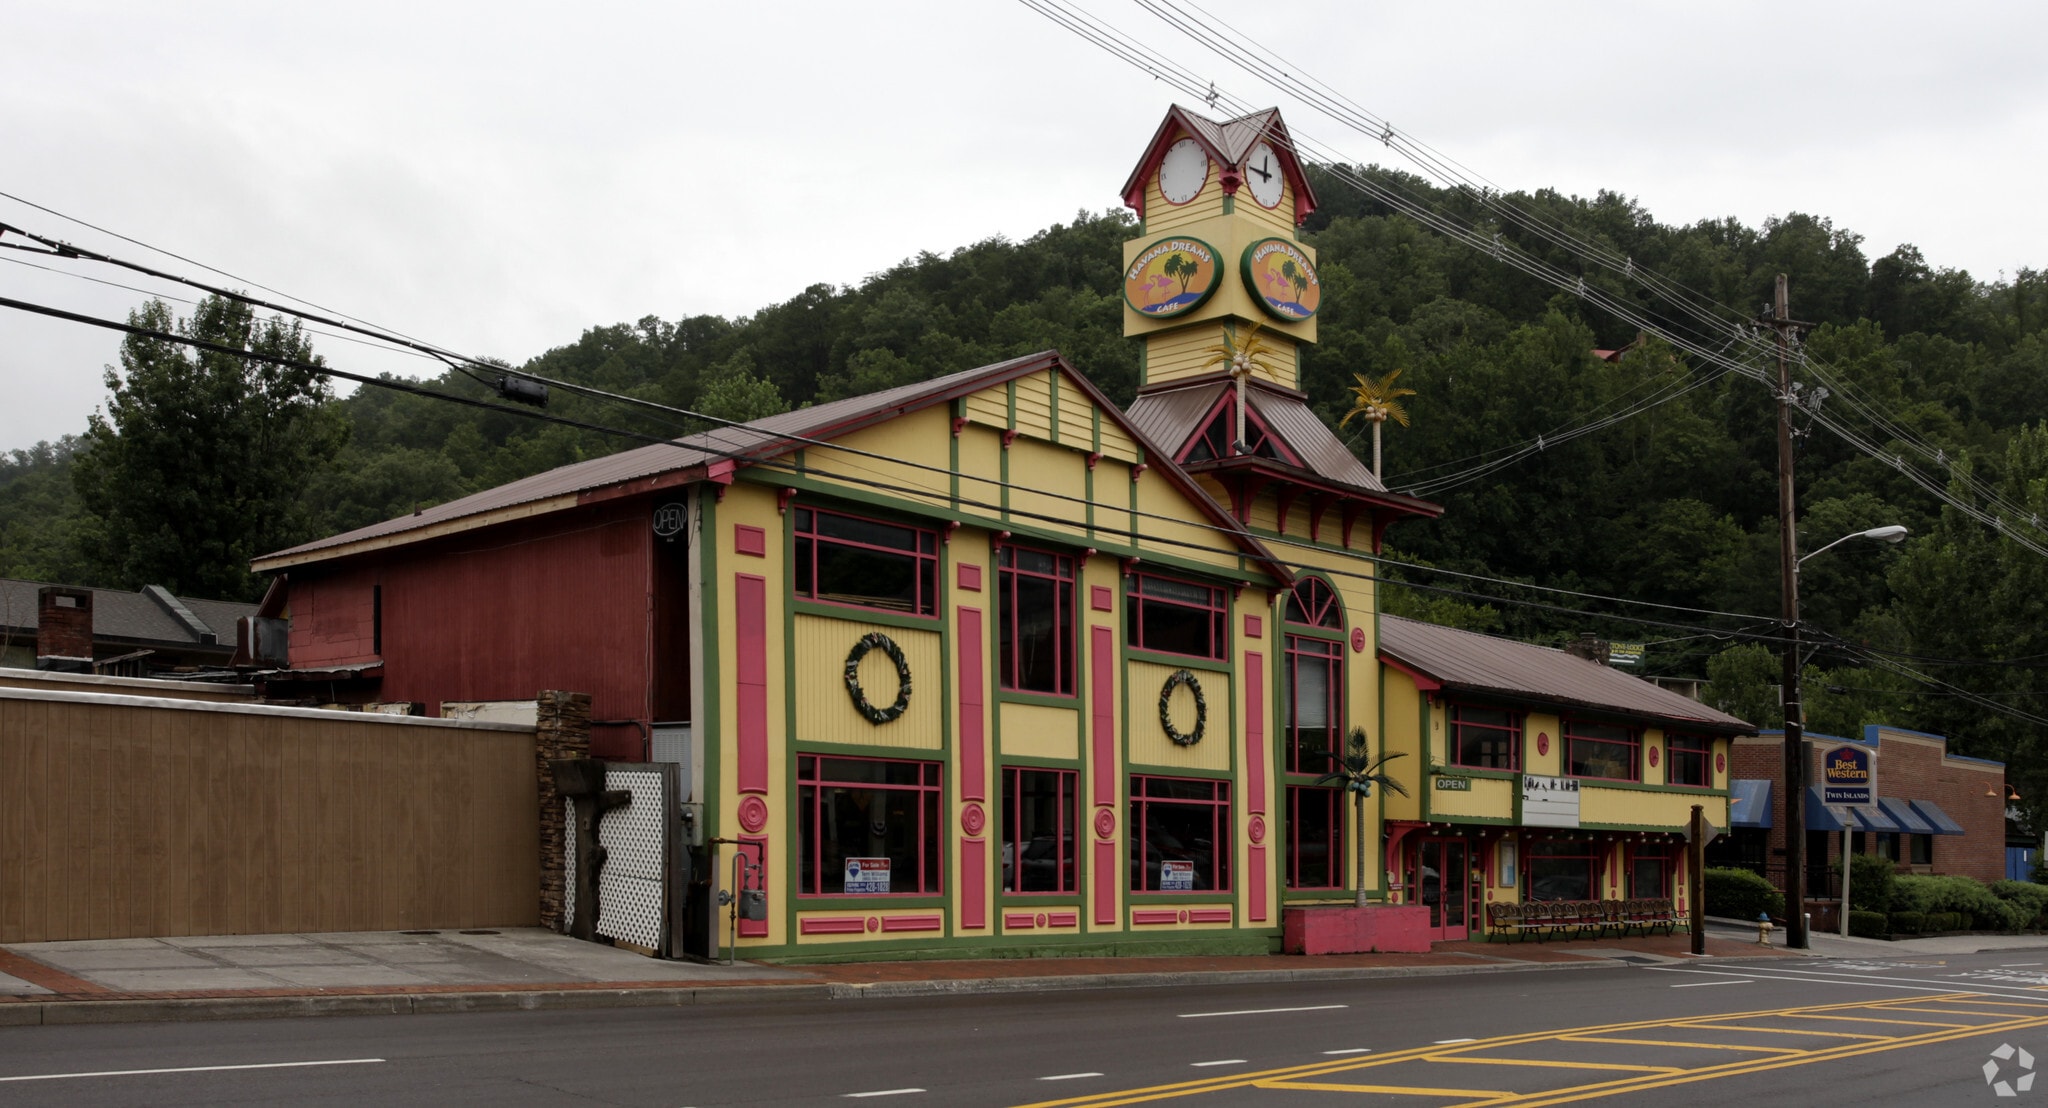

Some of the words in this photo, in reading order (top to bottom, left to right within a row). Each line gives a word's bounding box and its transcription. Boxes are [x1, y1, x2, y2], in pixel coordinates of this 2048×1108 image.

[1129, 246, 1168, 280] HAVANA
[1171, 241, 1211, 263] DREAMS
[1254, 244, 1286, 263] HAVANA
[1288, 246, 1318, 286] DREAMS
[1156, 302, 1178, 313] CAFE
[1277, 303, 1294, 315] CAFE
[653, 509, 685, 530] OPEN
[1835, 760, 1857, 769] Best
[1827, 768, 1867, 778] Western
[1437, 779, 1466, 789] OPEN
